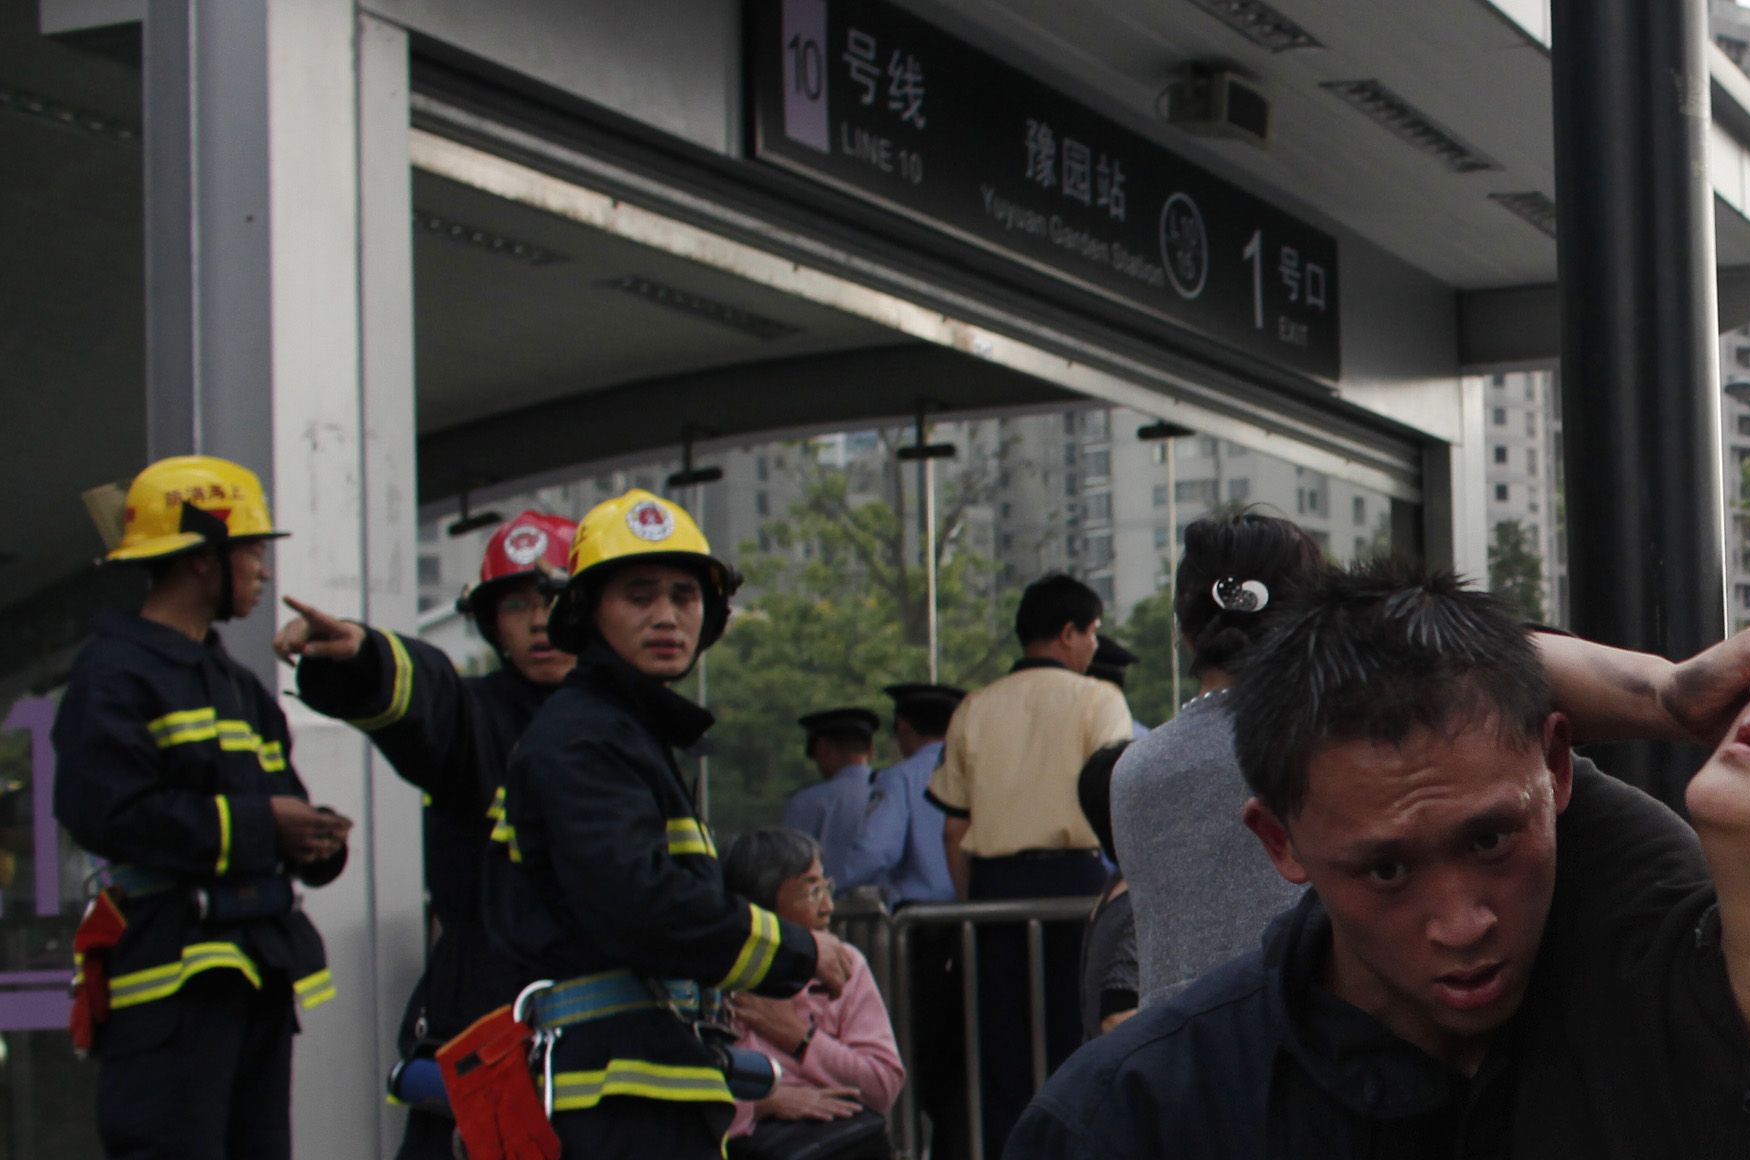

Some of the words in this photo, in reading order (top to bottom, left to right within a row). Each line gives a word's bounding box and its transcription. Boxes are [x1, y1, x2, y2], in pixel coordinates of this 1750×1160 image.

[786, 32, 823, 102] 10
[841, 27, 927, 130] 号线
[841, 121, 894, 173] LINE
[897, 148, 924, 185] 10
[1024, 117, 1127, 222] 豫园站
[979, 183, 1047, 237] Yuyuan
[1048, 213, 1110, 263] Garden
[1111, 242, 1165, 287] Station
[1241, 228, 1264, 332] 1
[1278, 245, 1327, 312] 号口
[1278, 315, 1309, 350] EXIT
